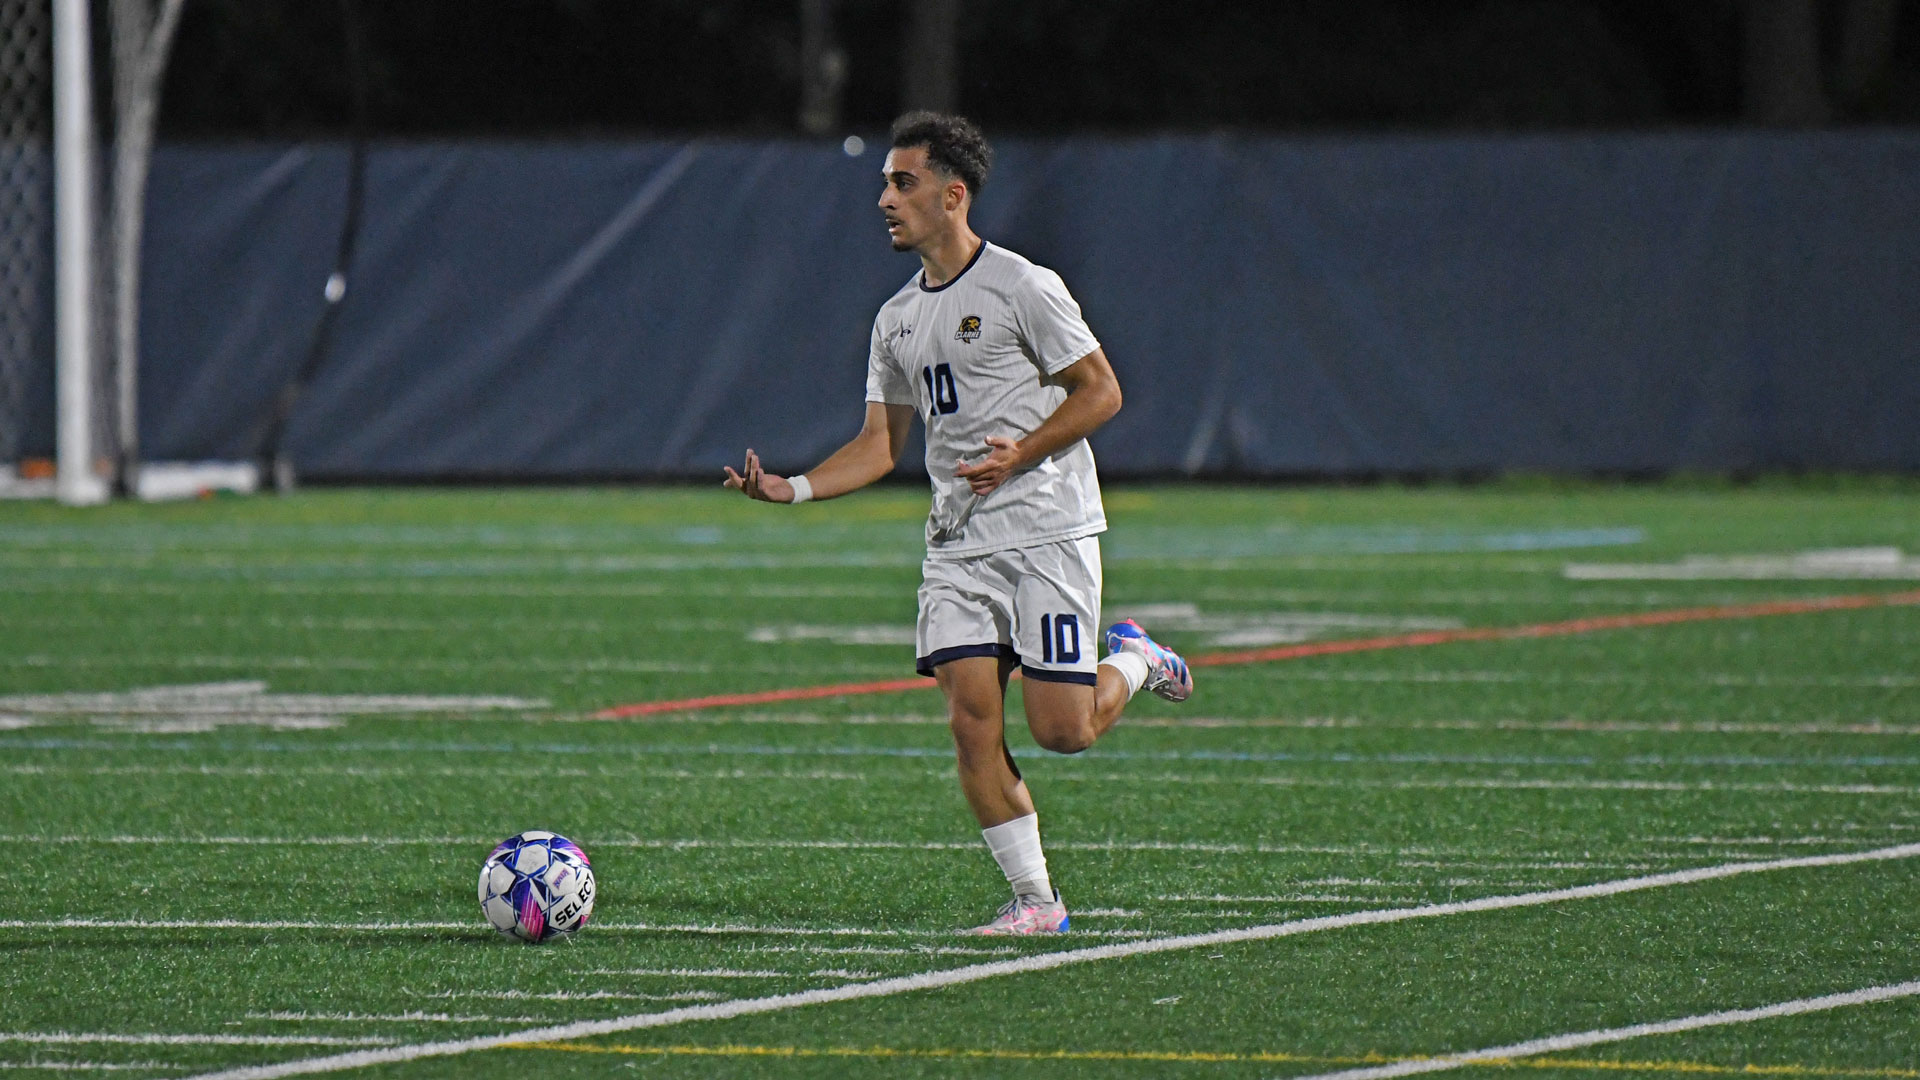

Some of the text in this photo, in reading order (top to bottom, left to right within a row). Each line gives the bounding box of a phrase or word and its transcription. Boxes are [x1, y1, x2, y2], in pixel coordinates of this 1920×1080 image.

[923, 363, 959, 416] 10
[1041, 613, 1080, 664] 10
[555, 873, 594, 926] SELECT
